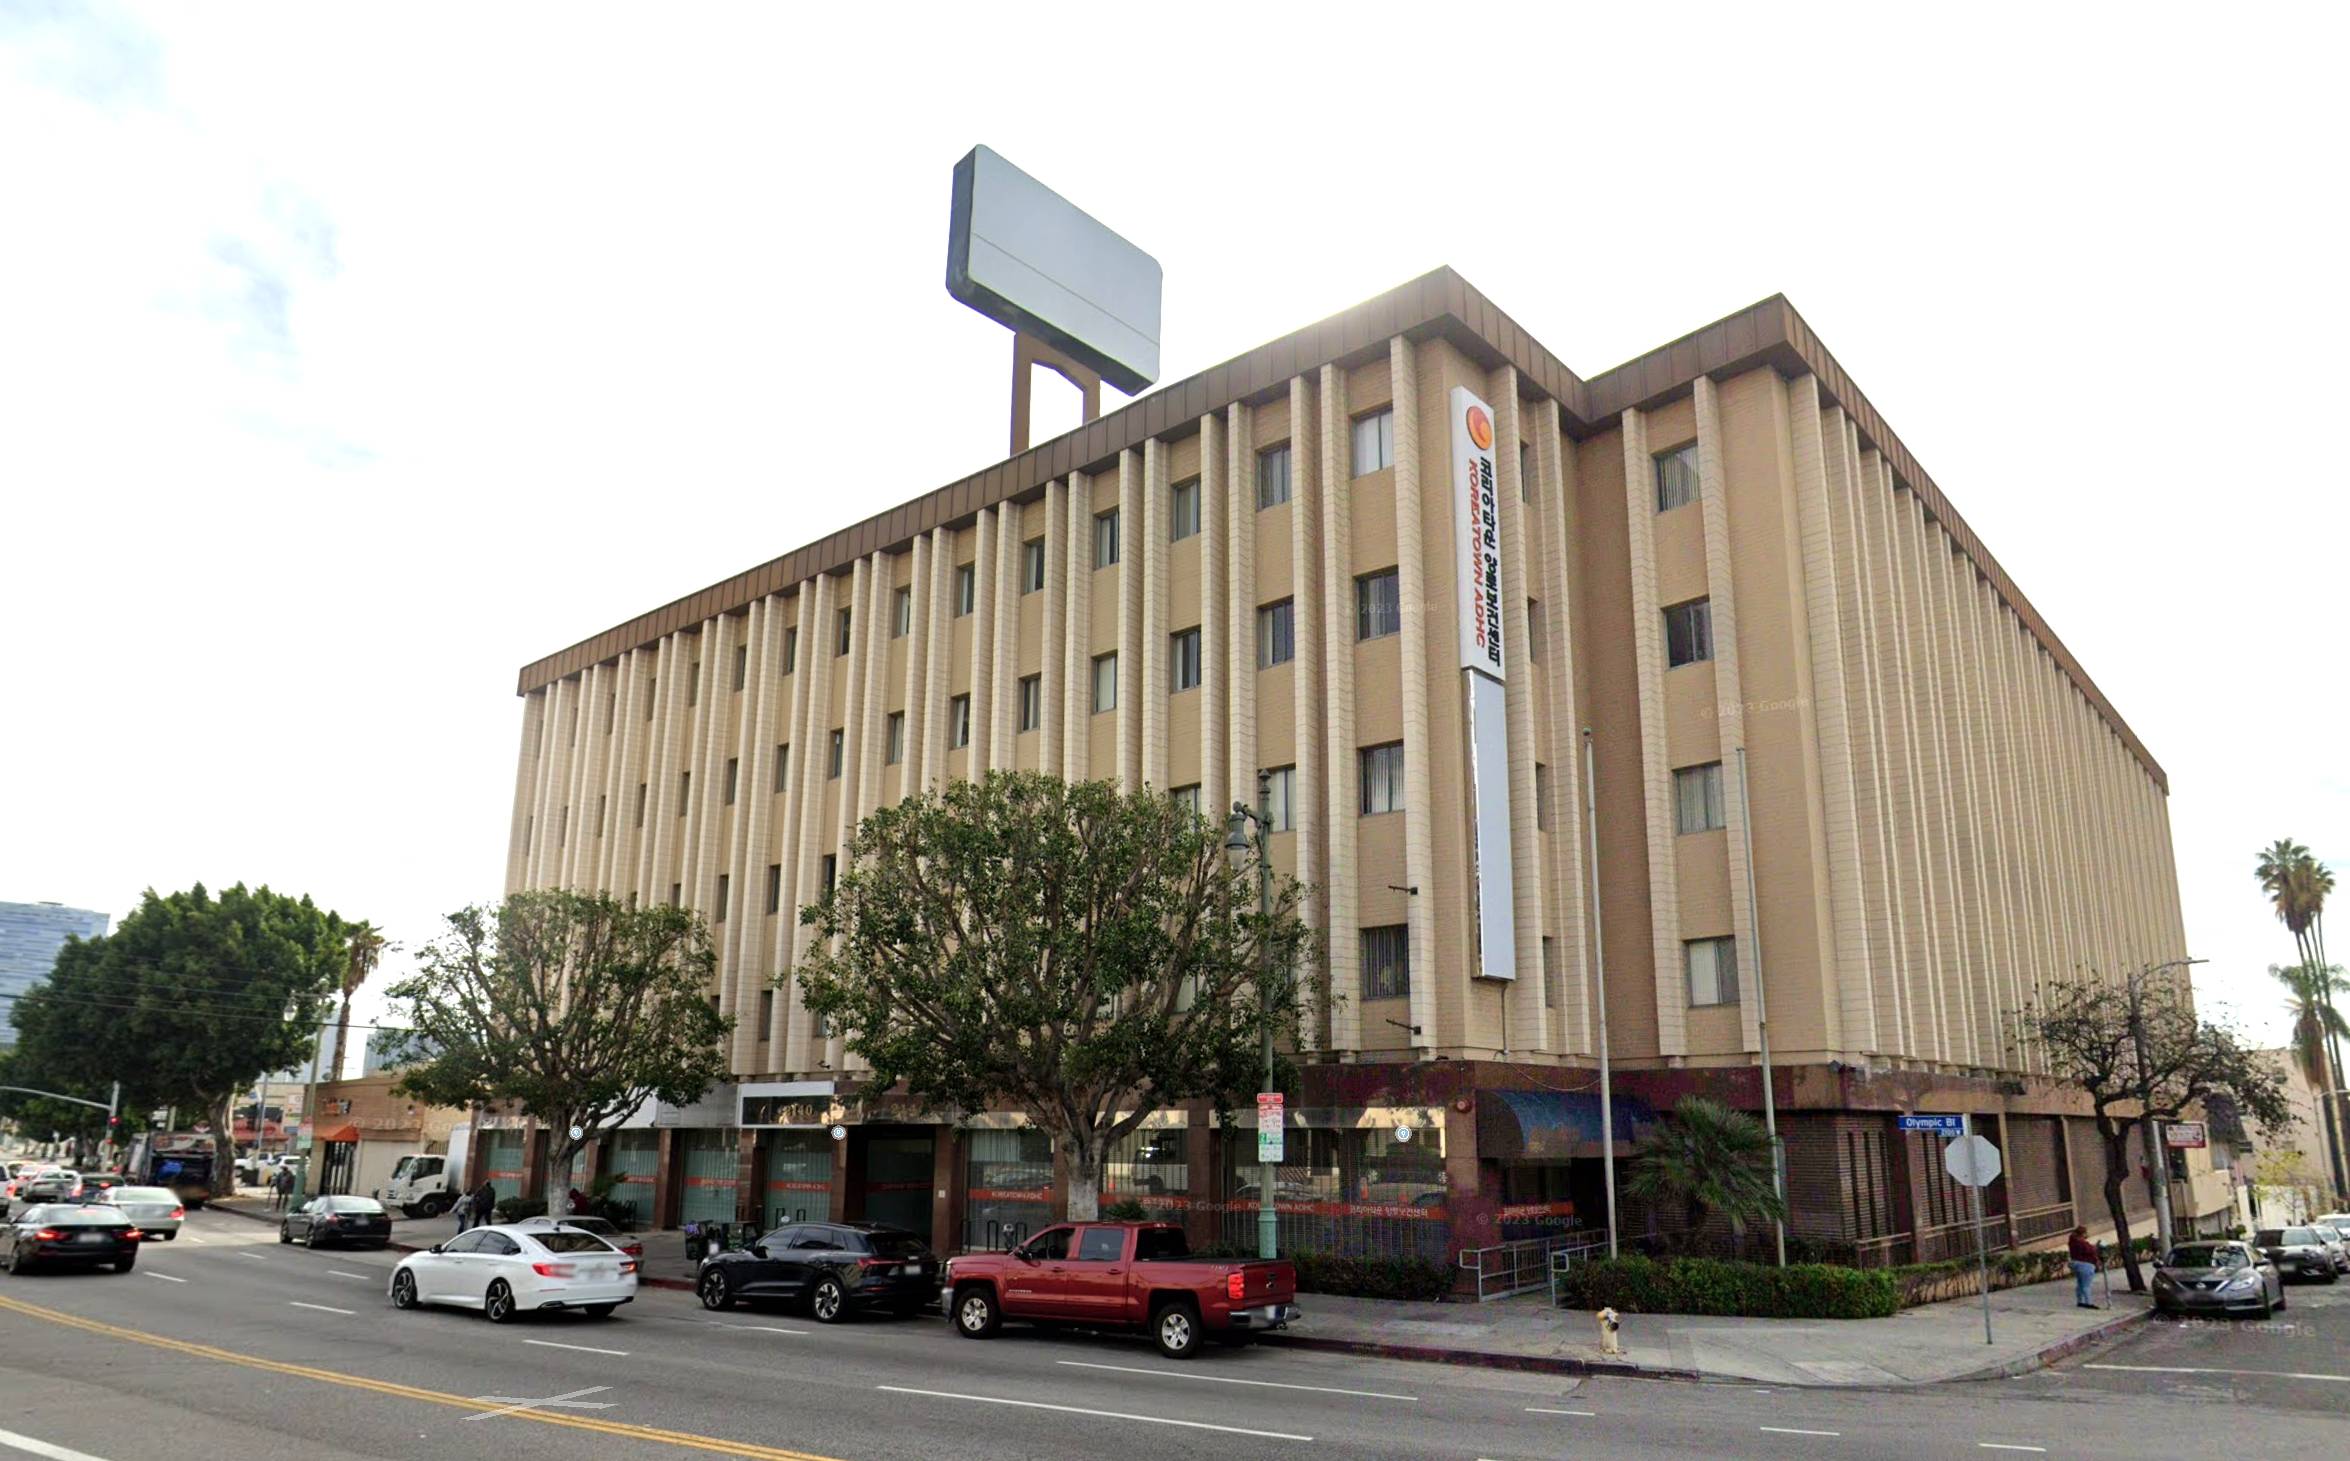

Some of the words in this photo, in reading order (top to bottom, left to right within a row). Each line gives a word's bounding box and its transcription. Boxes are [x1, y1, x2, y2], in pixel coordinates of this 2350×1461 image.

[1469, 459, 1483, 586] KOREATOWN
[1480, 457, 1496, 550] 코리아타운
[1475, 590, 1486, 648] ADHC
[1484, 554, 1501, 667] 양로보건센터
[1906, 1118, 1942, 1128] Olympic
[1945, 1118, 1957, 1127] Bl
